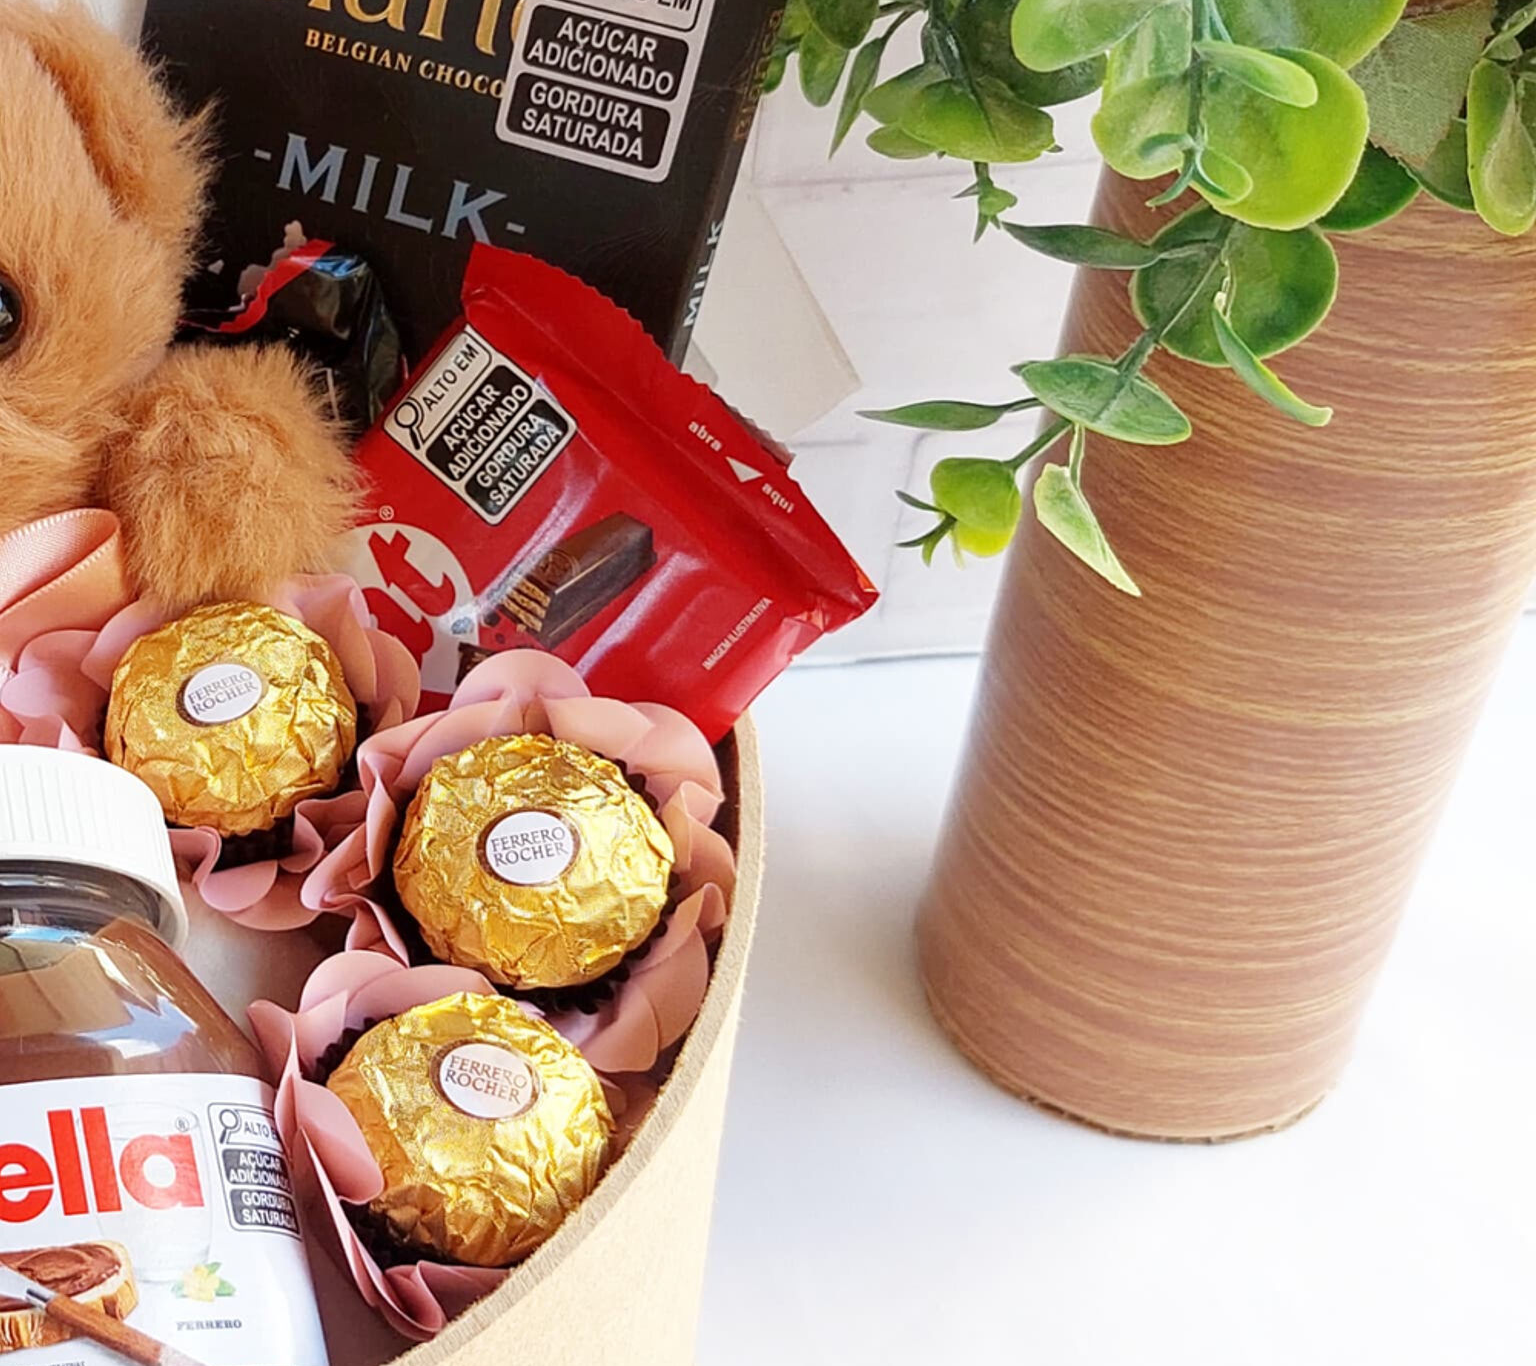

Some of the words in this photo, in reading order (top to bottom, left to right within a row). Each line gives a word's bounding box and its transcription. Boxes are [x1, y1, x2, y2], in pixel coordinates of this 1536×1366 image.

[305, 28, 412, 74] BELGIAN
[556, 16, 657, 63] AÇÚCAR
[527, 37, 674, 96] ADICIONADO
[529, 81, 644, 133] GORDURA
[521, 108, 644, 162] SATURADA
[422, 368, 458, 412] ALTO
[453, 343, 480, 373] EM
[443, 384, 502, 451] AÇÚCAR
[447, 384, 528, 479] ADICIONADO
[688, 419, 723, 453] abra
[476, 412, 545, 488] GORDURA
[489, 424, 563, 506] SATURADA
[762, 482, 795, 515] aqui
[701, 636, 732, 671] IMAGEM
[187, 670, 252, 705] FERRERO
[192, 681, 258, 716] ROCHER
[490, 826, 566, 853] FERRERO
[493, 841, 569, 867] ROCHER
[444, 1068, 521, 1105] ROCHER
[449, 1054, 528, 1089] FERRERO
[244, 1121, 270, 1138] ALTO
[175, 1319, 242, 1332] FERRERO
